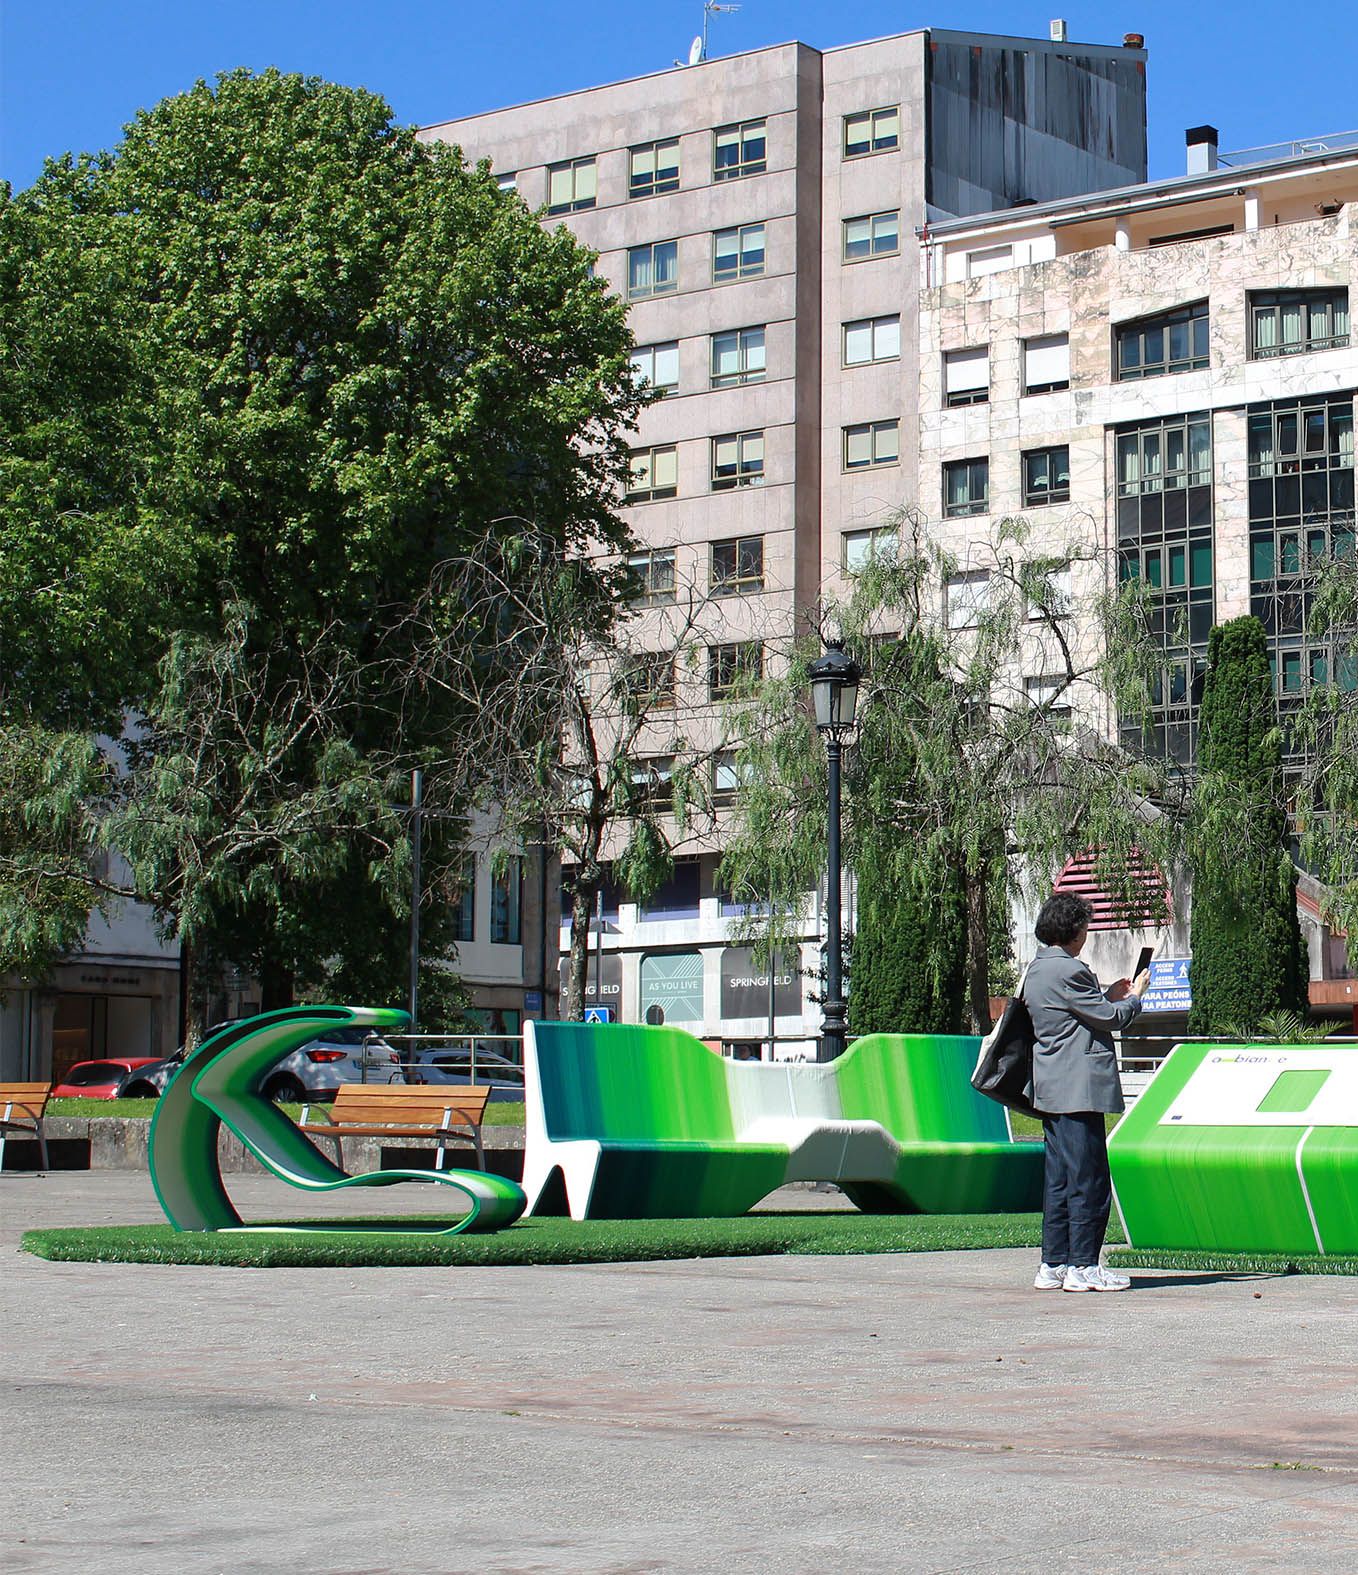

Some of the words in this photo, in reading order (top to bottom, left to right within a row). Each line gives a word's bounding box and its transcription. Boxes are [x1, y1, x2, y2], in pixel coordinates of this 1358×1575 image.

[649, 983, 659, 991] AS
[661, 982, 679, 990] YOU
[680, 980, 698, 989] LIVE
[1163, 990, 1189, 999] PEÓNS
[1156, 1000, 1192, 1008] PEATONE
